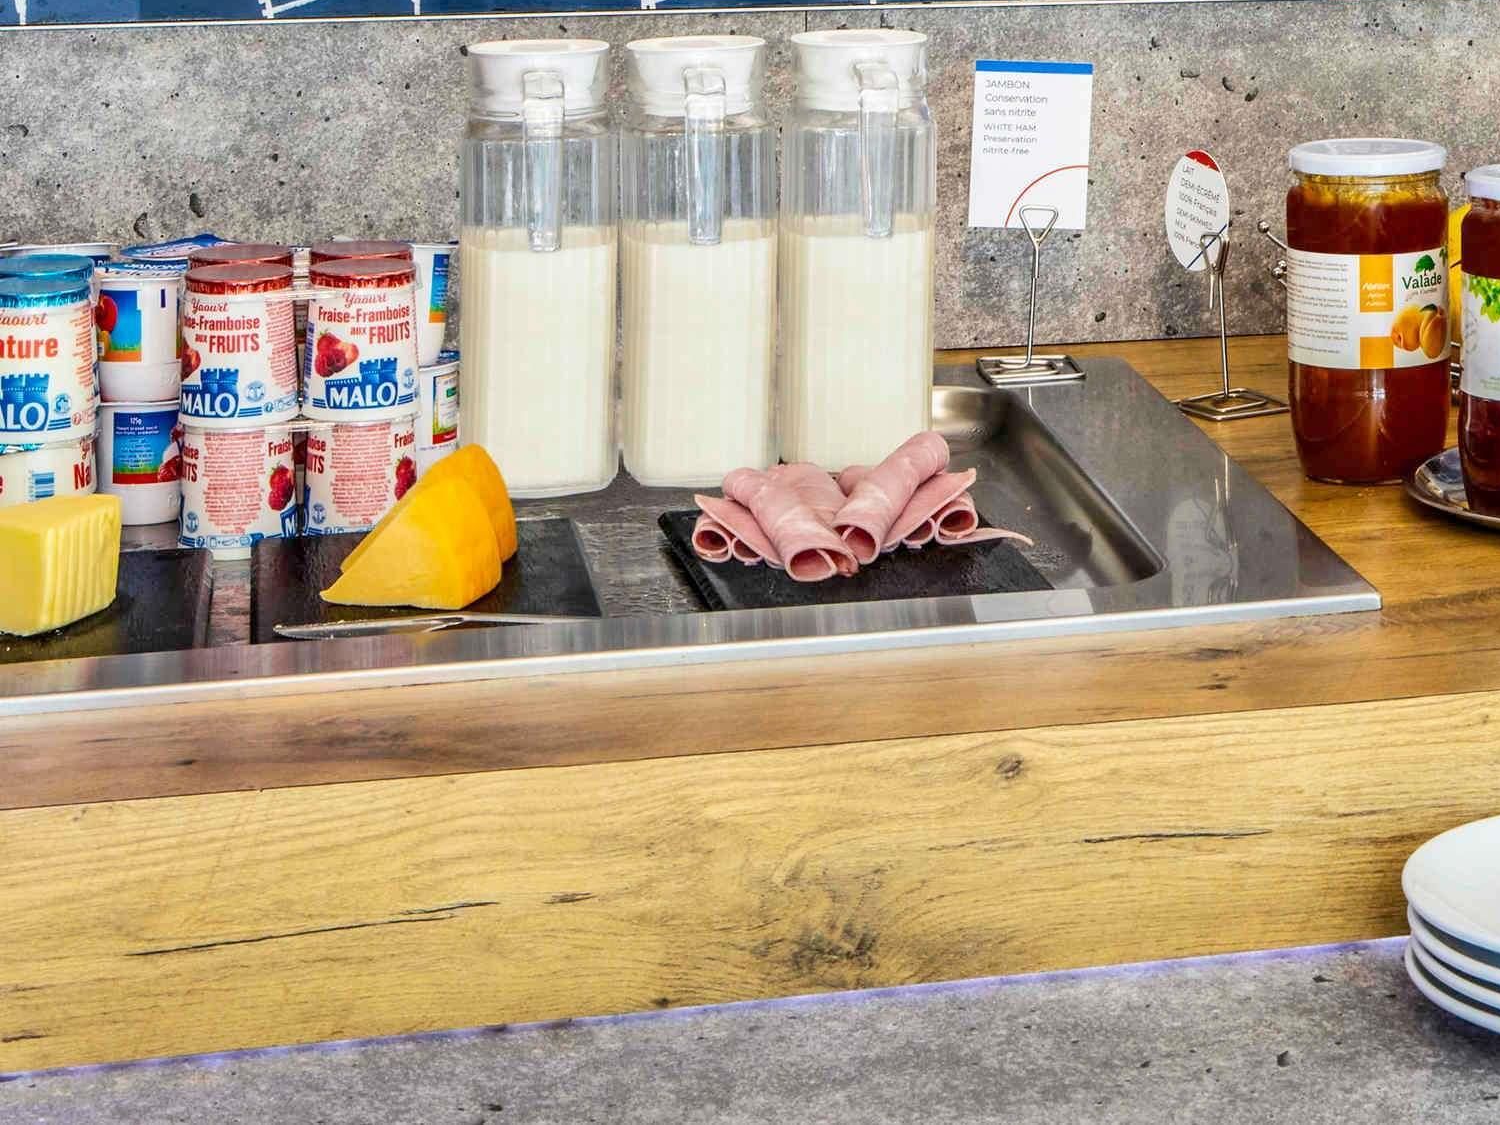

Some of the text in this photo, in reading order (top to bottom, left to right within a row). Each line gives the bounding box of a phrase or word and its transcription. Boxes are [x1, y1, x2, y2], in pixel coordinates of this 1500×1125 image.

[984, 79, 1031, 90] JAMBON
[984, 93, 1049, 104] Conservation
[984, 107, 1037, 117] sans nitrite
[984, 123, 1037, 132] WHITE HAM
[983, 135, 1038, 144] Preservation
[1402, 272, 1442, 291] Valade
[191, 297, 228, 314] Yaourt
[342, 291, 388, 308] Yaourt
[319, 303, 411, 323] Fraise-Framboise
[369, 320, 411, 345] FRUITS
[209, 333, 261, 354] FRUITS
[329, 381, 397, 408] MALO
[181, 393, 236, 417] MALO
